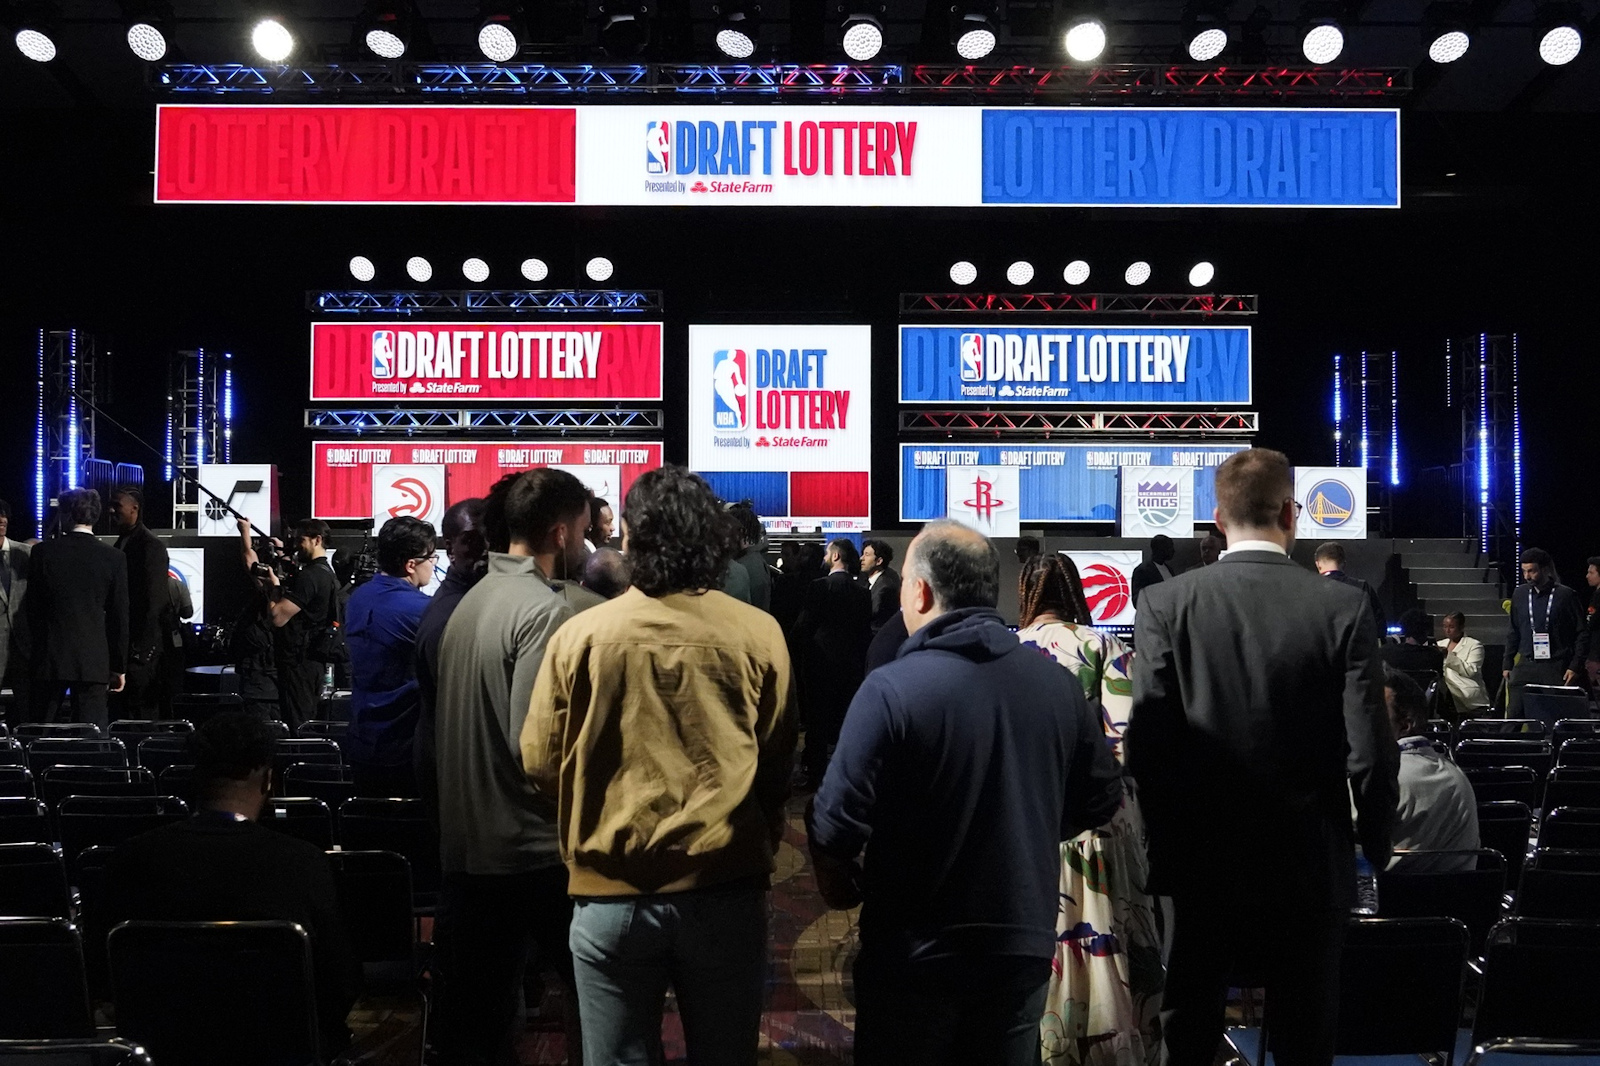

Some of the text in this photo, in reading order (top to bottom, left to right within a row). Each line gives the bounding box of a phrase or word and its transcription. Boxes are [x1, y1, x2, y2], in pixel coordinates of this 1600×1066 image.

[378, 114, 526, 195] DRAFT
[676, 120, 917, 177] DRAFT LOTTERY
[1203, 117, 1349, 198] DRAFT
[644, 180, 677, 192] Presented
[678, 180, 686, 194] by
[397, 331, 484, 378] DRAFT
[488, 331, 602, 379] LOTTERY
[986, 334, 1072, 382] DRAFT
[1076, 335, 1190, 382] LOTTERY
[756, 349, 827, 389] DRAFT
[372, 381, 399, 393] Presented
[399, 381, 407, 394] by
[961, 384, 988, 396] Presented
[988, 384, 996, 397] by
[756, 390, 850, 430] LOTTERY
[716, 412, 735, 425] NBA
[714, 436, 743, 447] Presented
[743, 436, 750, 449] by
[334, 449, 391, 463] DRAFT LOTTERY
[419, 449, 477, 463] DRAFT LOTTERY
[506, 449, 563, 463] DRAFT LOTTERY
[591, 449, 649, 463] DRAFT LOTTERY
[921, 451, 979, 465] DRAFT LOTTERY
[1008, 452, 1065, 465] DRAFT LOTTERY
[1094, 452, 1151, 466] DRAFT LOTTERY
[1179, 452, 1204, 466] DRAFT
[1138, 498, 1178, 507] KINGS
